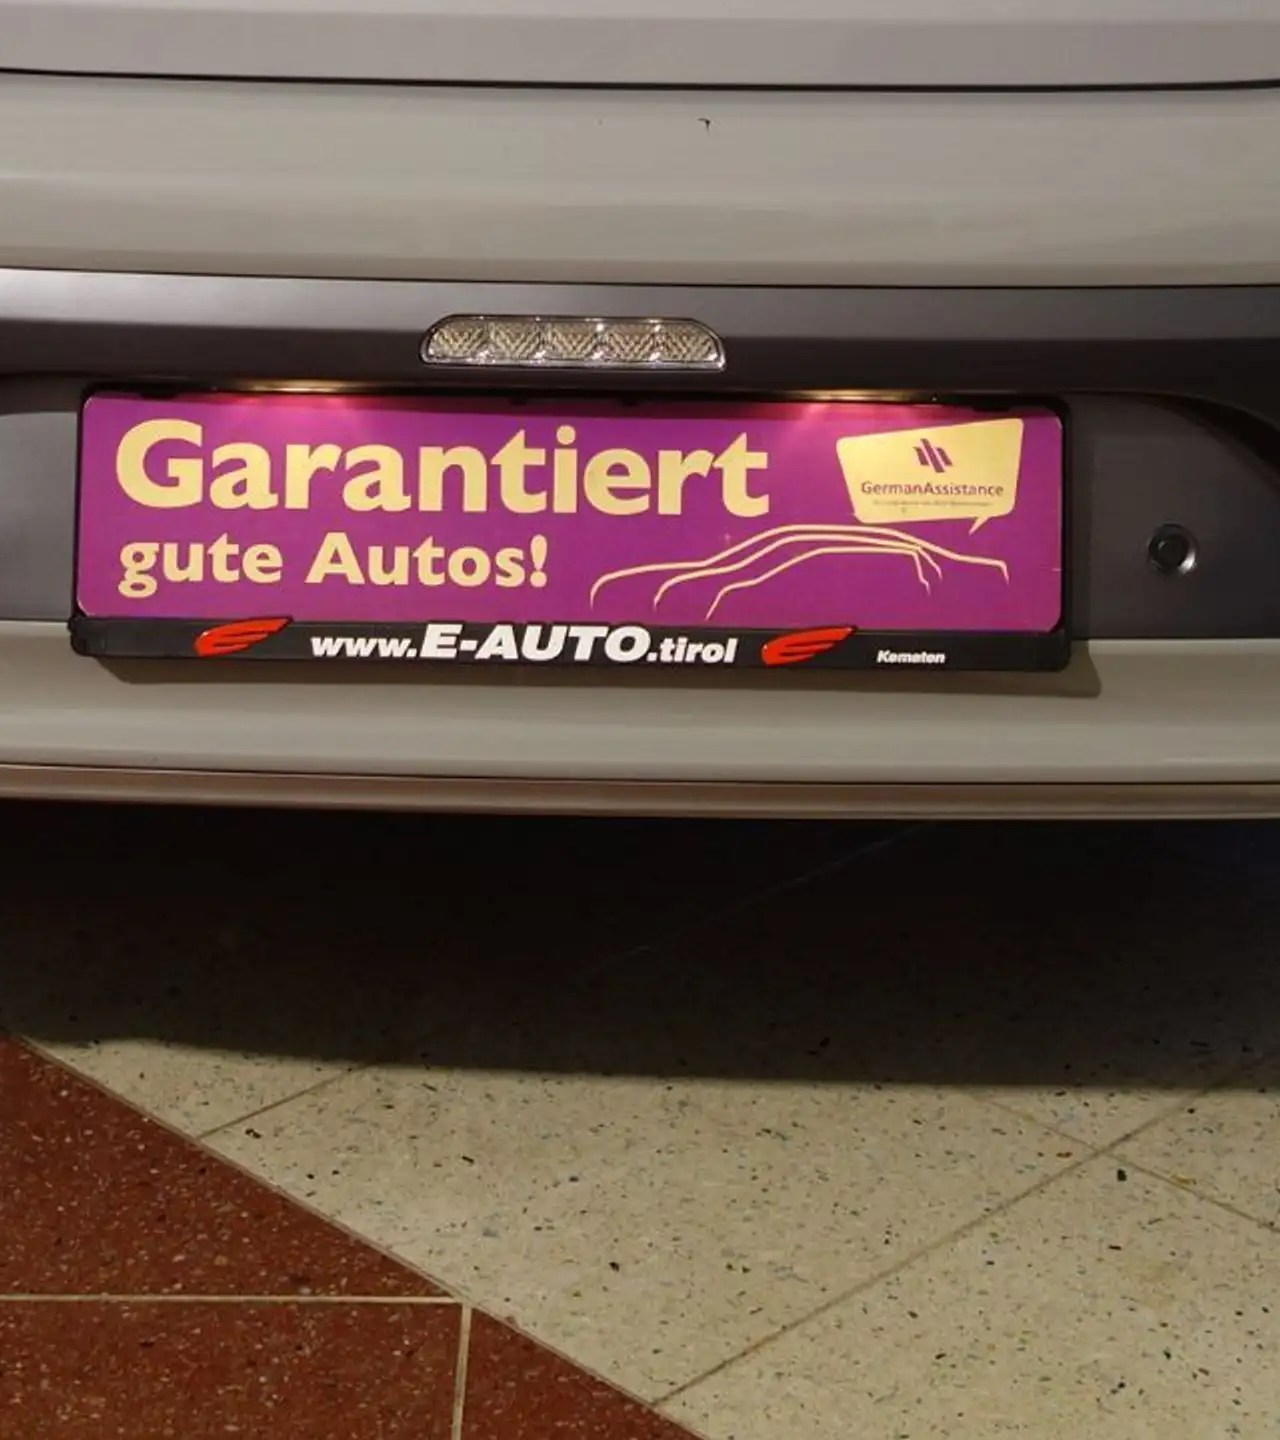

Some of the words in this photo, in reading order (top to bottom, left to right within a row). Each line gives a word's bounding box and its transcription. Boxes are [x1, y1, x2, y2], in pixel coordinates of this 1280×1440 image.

[116, 418, 770, 517] Garantiert
[860, 481, 1004, 497] GermanAssistance
[117, 532, 283, 599] gute
[305, 532, 549, 589] Autos!
[310, 623, 737, 664] www.E-AUTO.tirol
